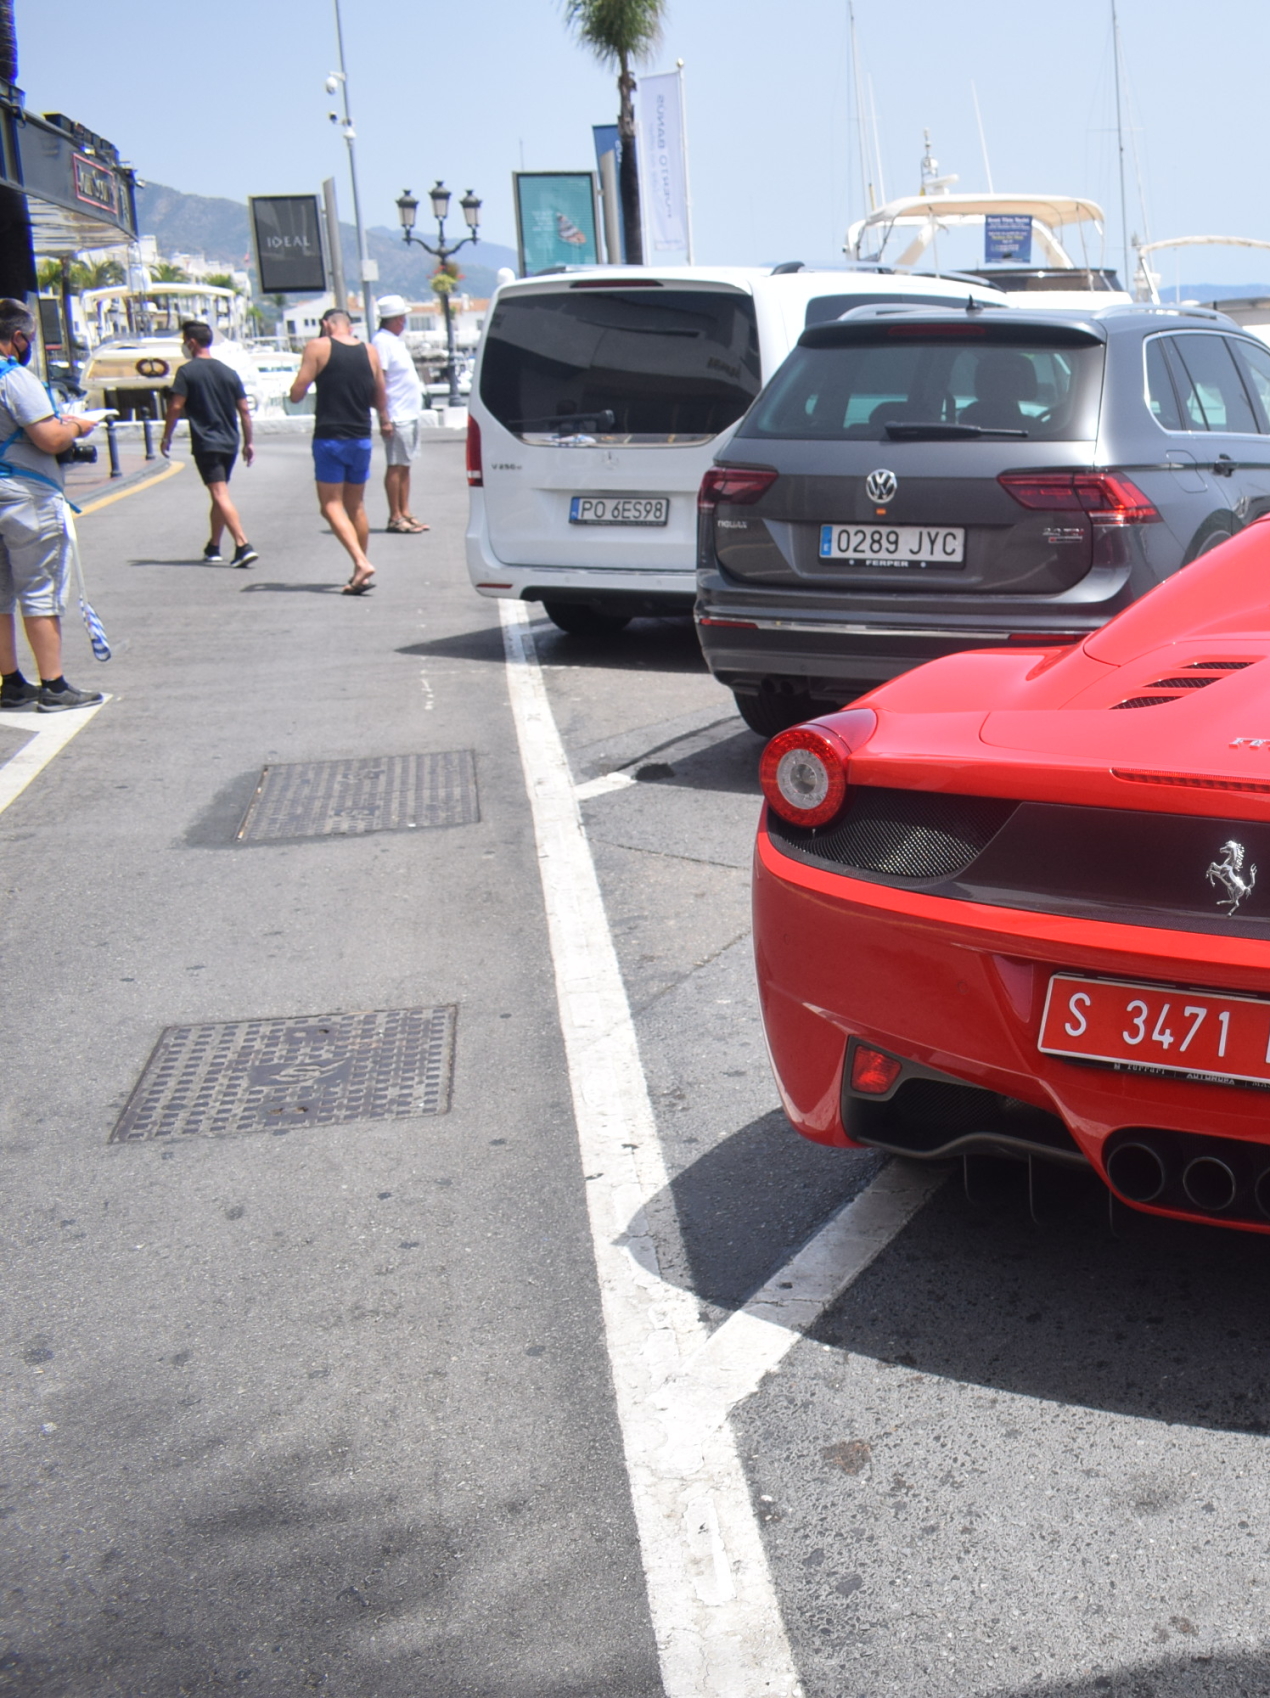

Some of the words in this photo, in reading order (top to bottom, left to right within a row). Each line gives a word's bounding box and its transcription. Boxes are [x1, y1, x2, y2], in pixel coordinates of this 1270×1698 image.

[266, 235, 311, 248] IDEAL
[580, 500, 606, 519] PO
[611, 501, 664, 520] 6ES98
[836, 529, 900, 554] 0289
[908, 530, 957, 556] JYC
[865, 559, 909, 568] FERPER
[1063, 991, 1092, 1037] S
[1122, 999, 1231, 1058] 3471
